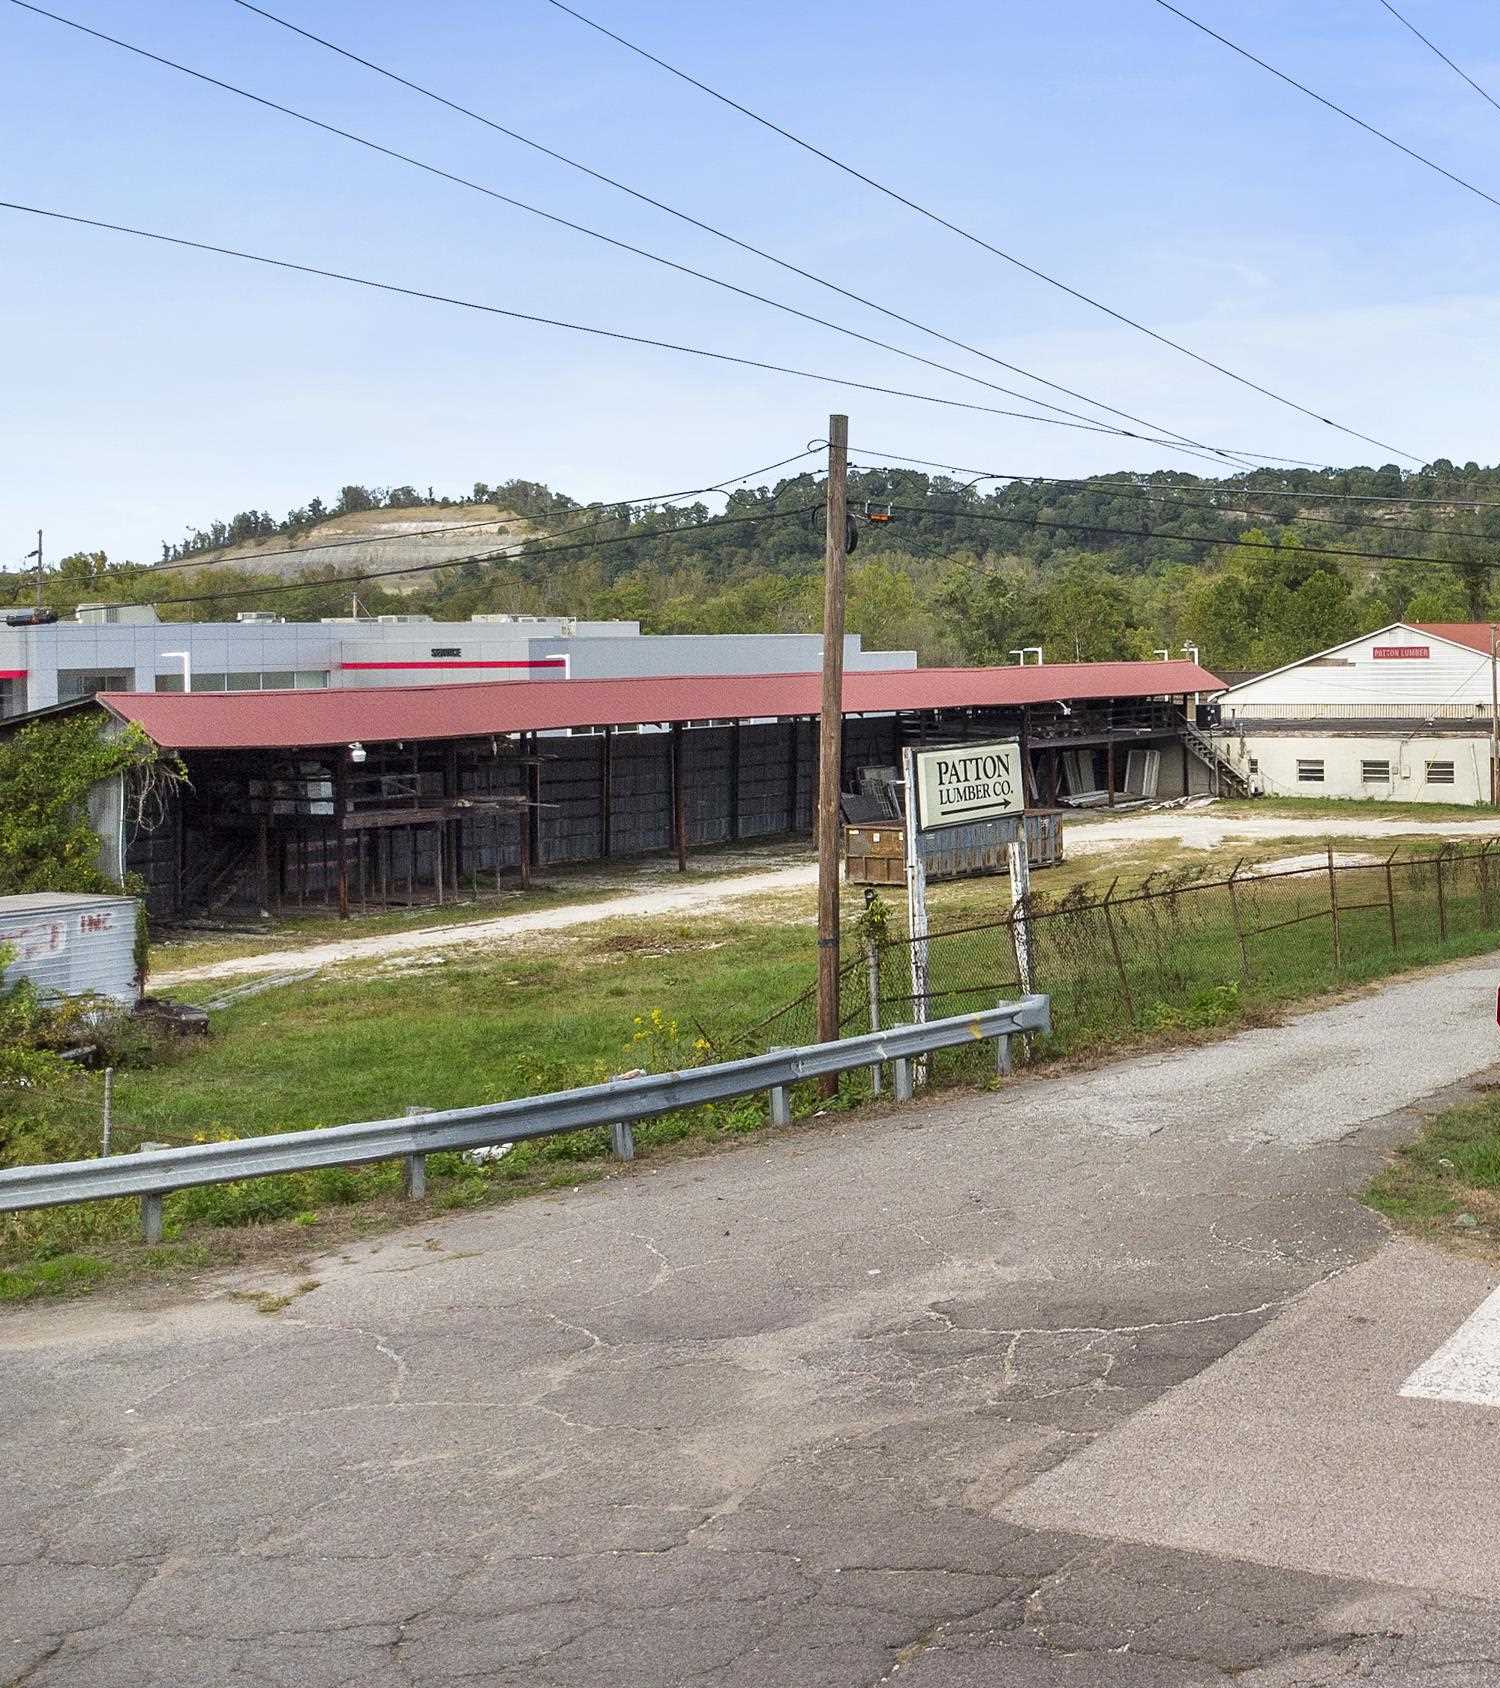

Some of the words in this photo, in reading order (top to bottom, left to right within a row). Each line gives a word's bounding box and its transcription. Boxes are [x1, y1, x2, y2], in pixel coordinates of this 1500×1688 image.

[1374, 648, 1400, 657] PATTON
[1401, 648, 1429, 657] LUMBER
[936, 754, 1010, 786] PATTON
[939, 783, 991, 806] LUMBER
[992, 780, 1014, 797] CO.
